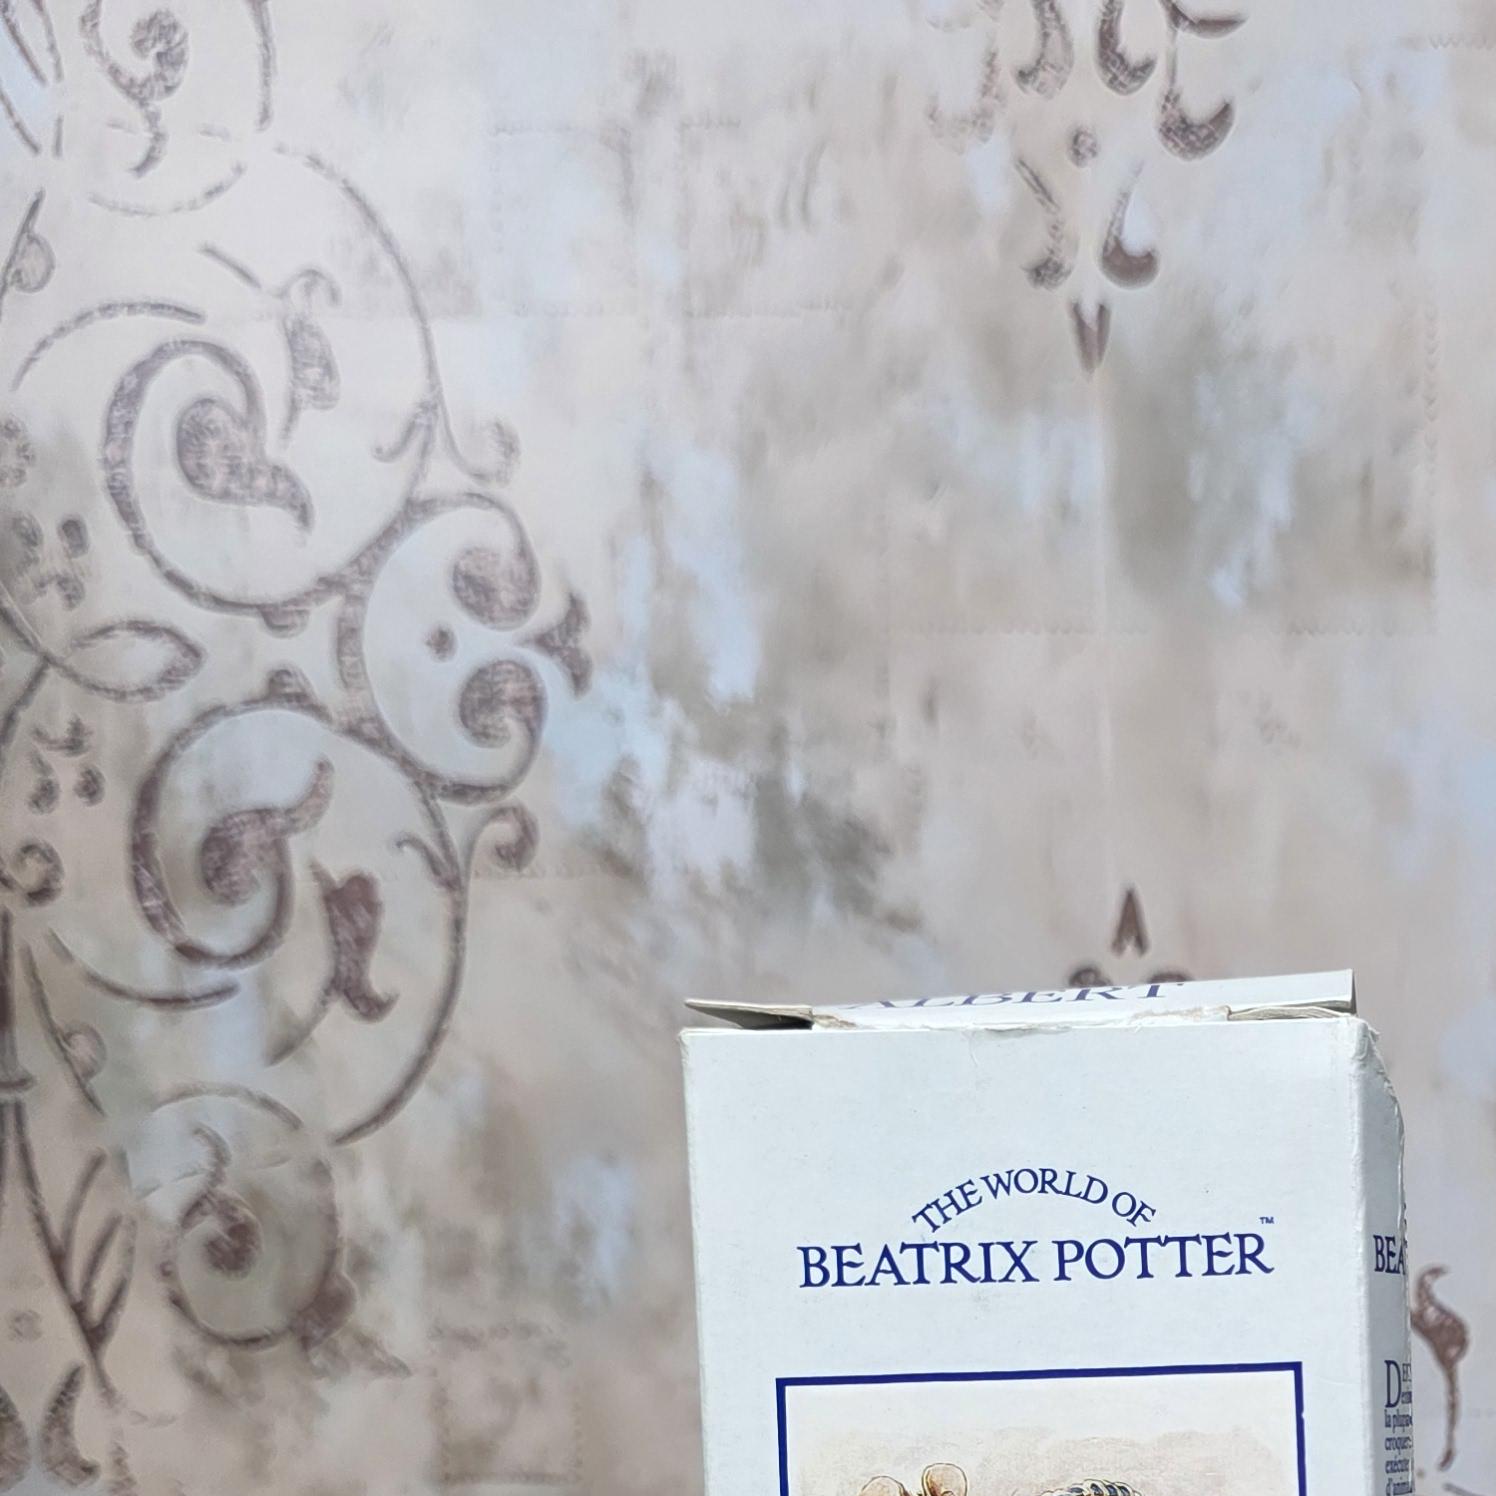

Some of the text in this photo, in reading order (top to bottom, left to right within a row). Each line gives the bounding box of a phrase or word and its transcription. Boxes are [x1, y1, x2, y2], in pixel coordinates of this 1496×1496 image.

[911, 1167, 1157, 1234] THE WORLD OF
[798, 1239, 1036, 1289] BEATRIX
[1053, 1232, 1275, 1282] POTTER
